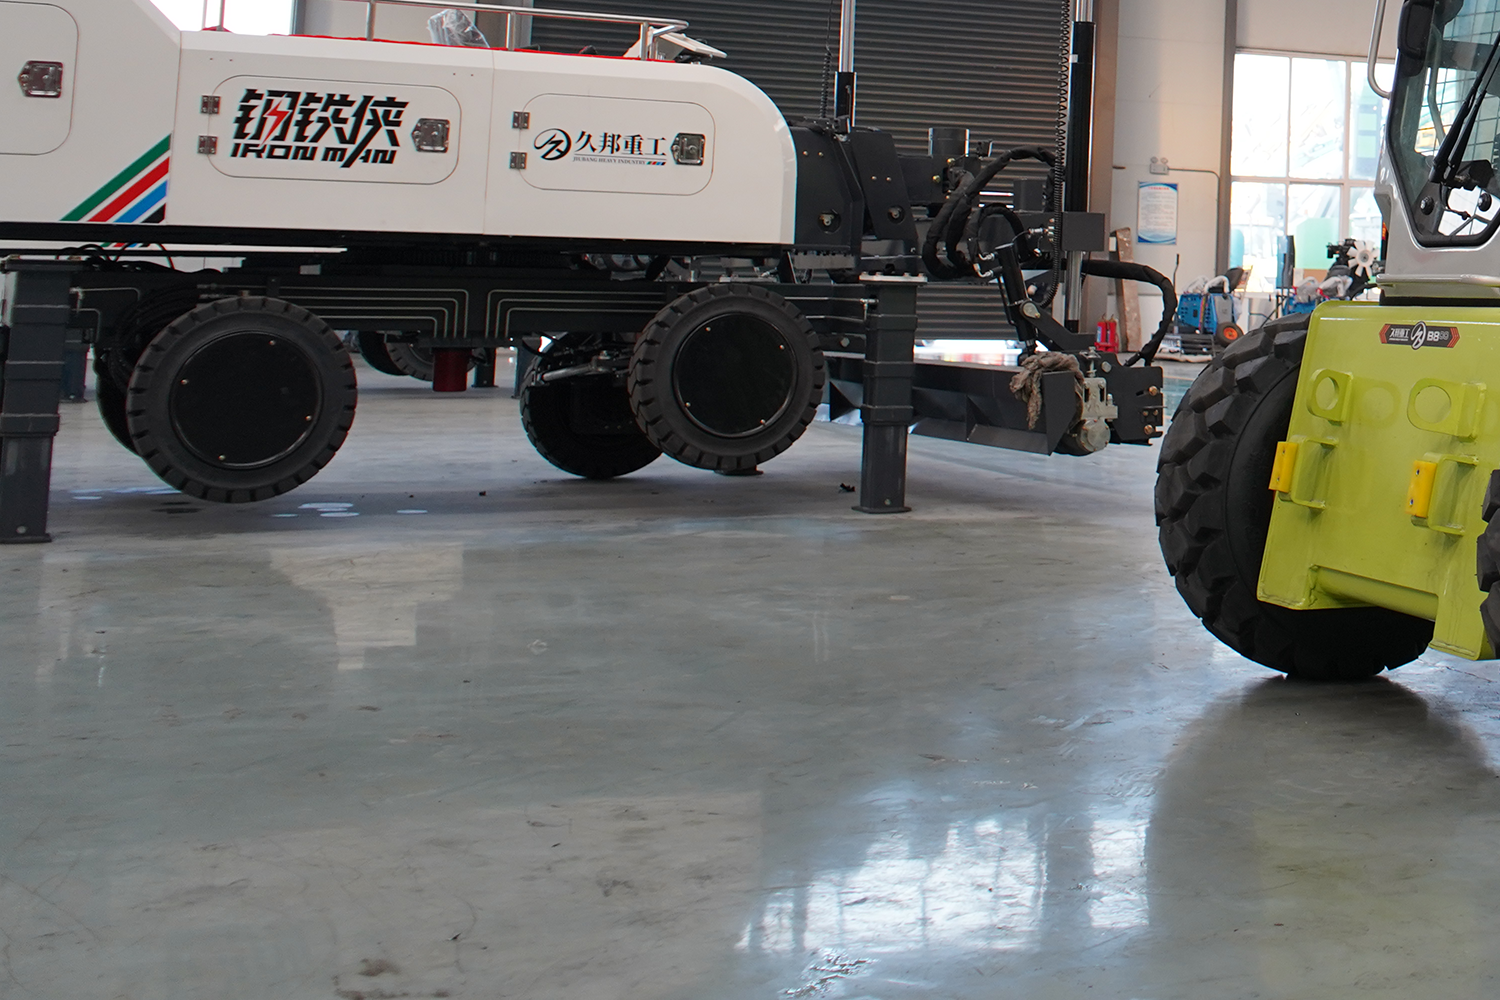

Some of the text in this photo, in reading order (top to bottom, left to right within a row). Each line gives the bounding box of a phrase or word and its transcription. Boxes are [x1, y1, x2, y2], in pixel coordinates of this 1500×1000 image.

[233, 88, 409, 168] 钢铁侠
[230, 143, 398, 164] IRON MAN
[574, 130, 667, 156] 久邦重工
